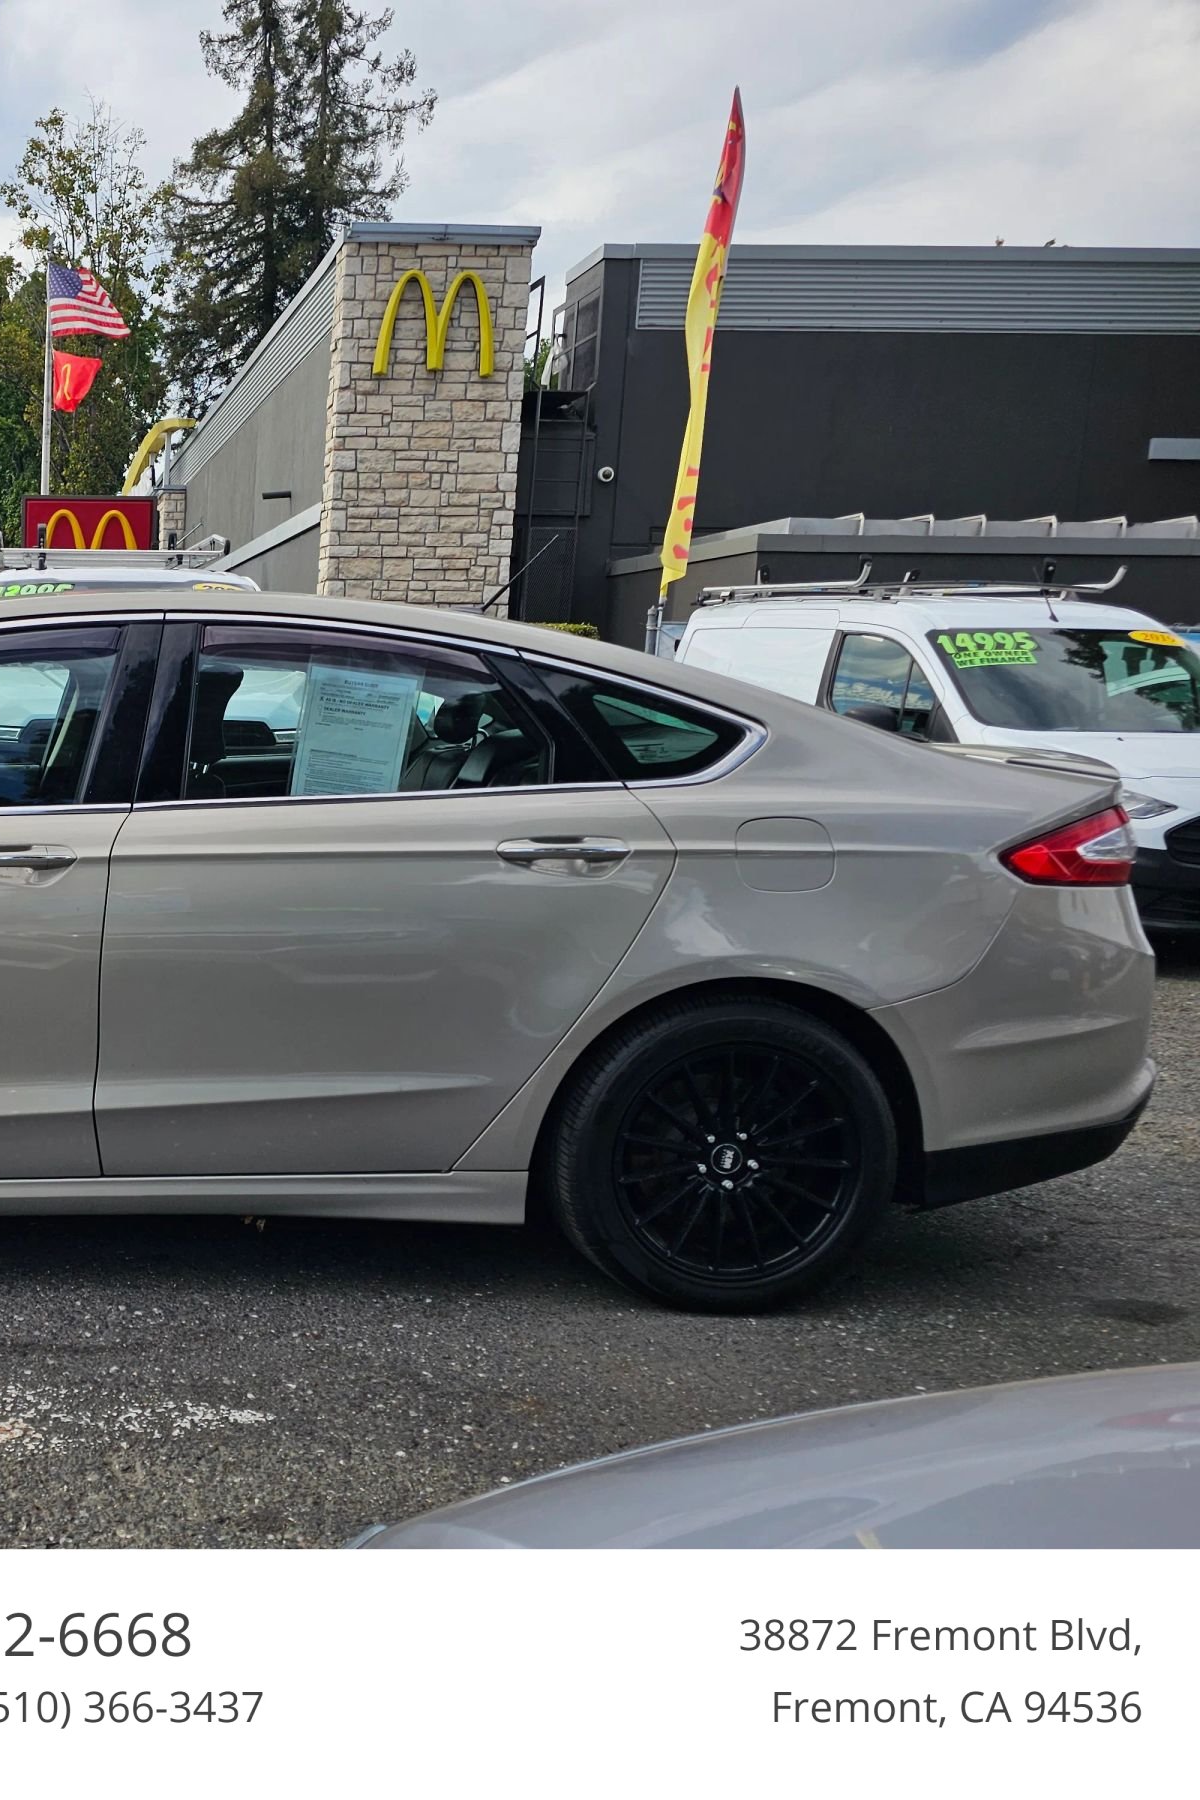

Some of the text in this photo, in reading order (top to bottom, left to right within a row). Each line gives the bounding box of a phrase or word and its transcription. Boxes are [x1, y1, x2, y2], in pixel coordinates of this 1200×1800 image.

[937, 631, 1036, 654] 14995
[954, 651, 980, 659] ONE
[956, 656, 1033, 667] WE FINANCE
